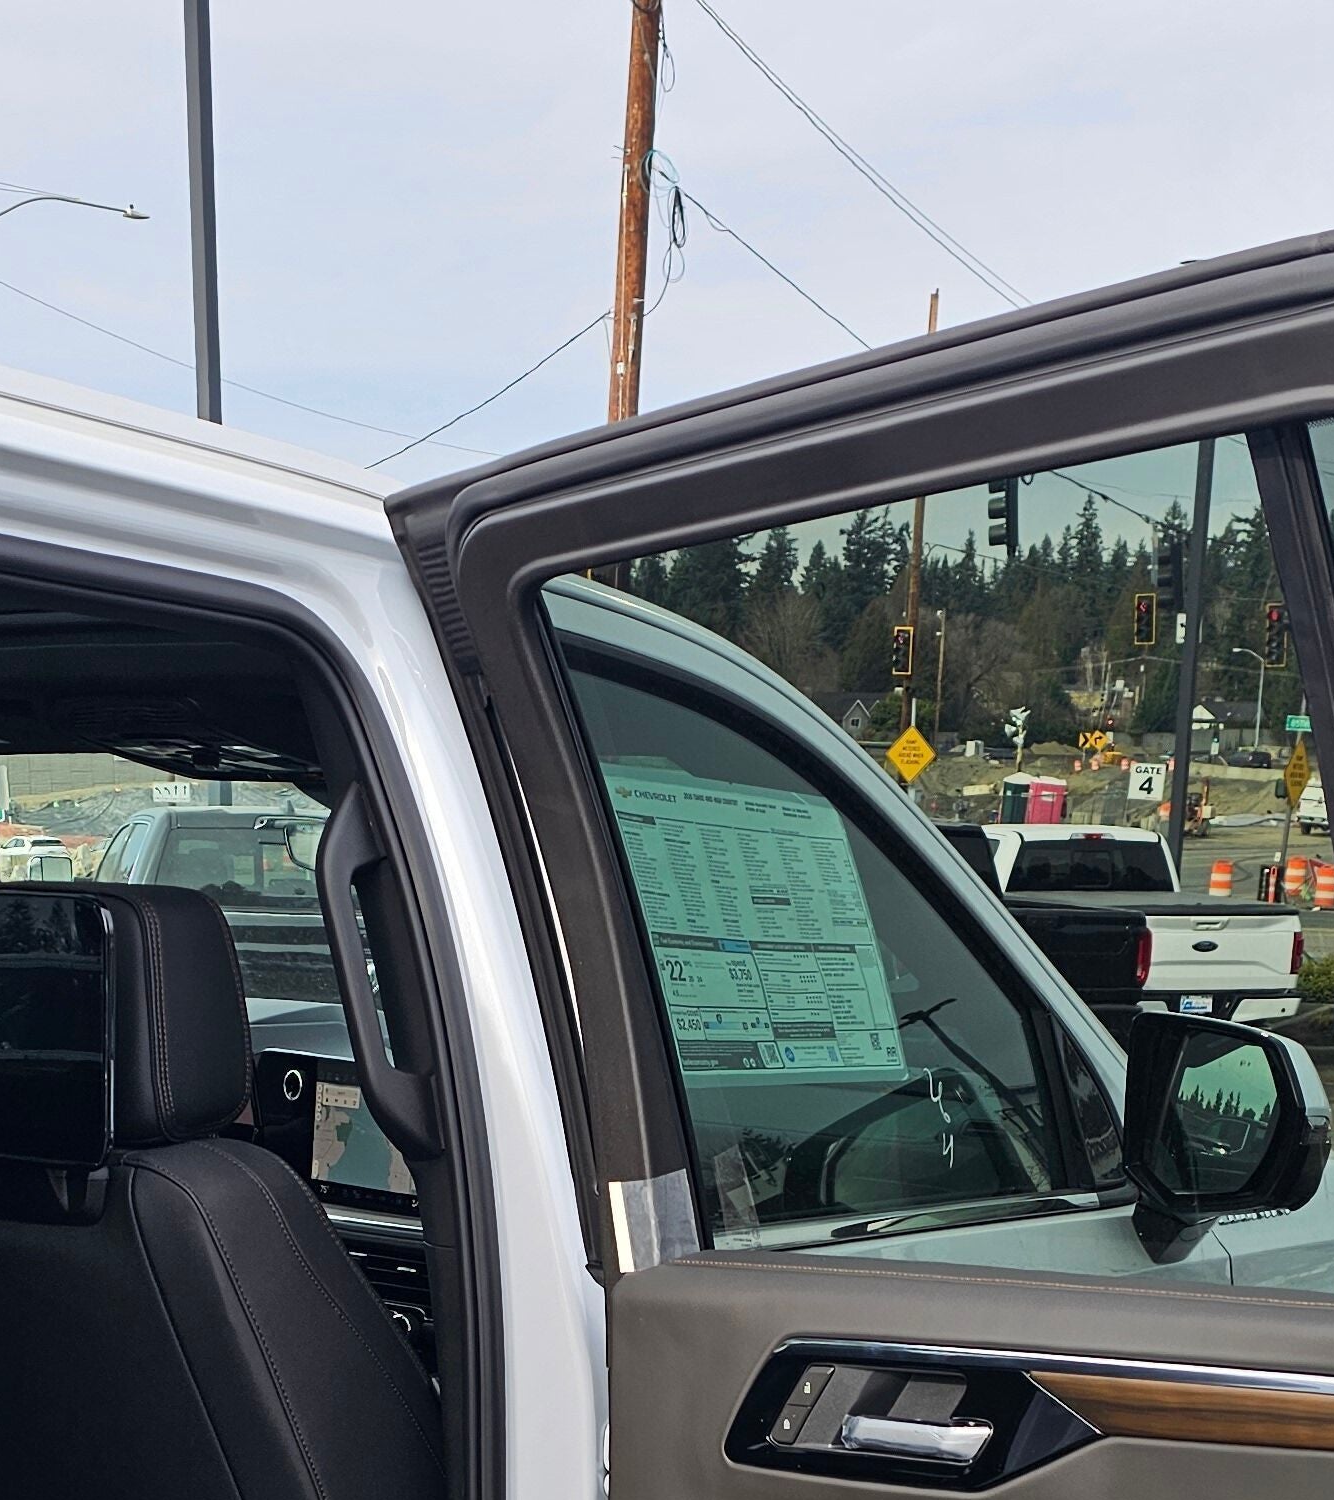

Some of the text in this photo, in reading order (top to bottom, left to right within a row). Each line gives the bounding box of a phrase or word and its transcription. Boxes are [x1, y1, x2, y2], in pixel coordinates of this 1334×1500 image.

[1135, 766, 1162, 775] GATE
[1139, 776, 1154, 795] 4
[634, 789, 677, 803] CHEVROLET
[666, 960, 686, 981] 22
[728, 968, 752, 980] $3,750
[676, 1018, 701, 1031] $2,450
